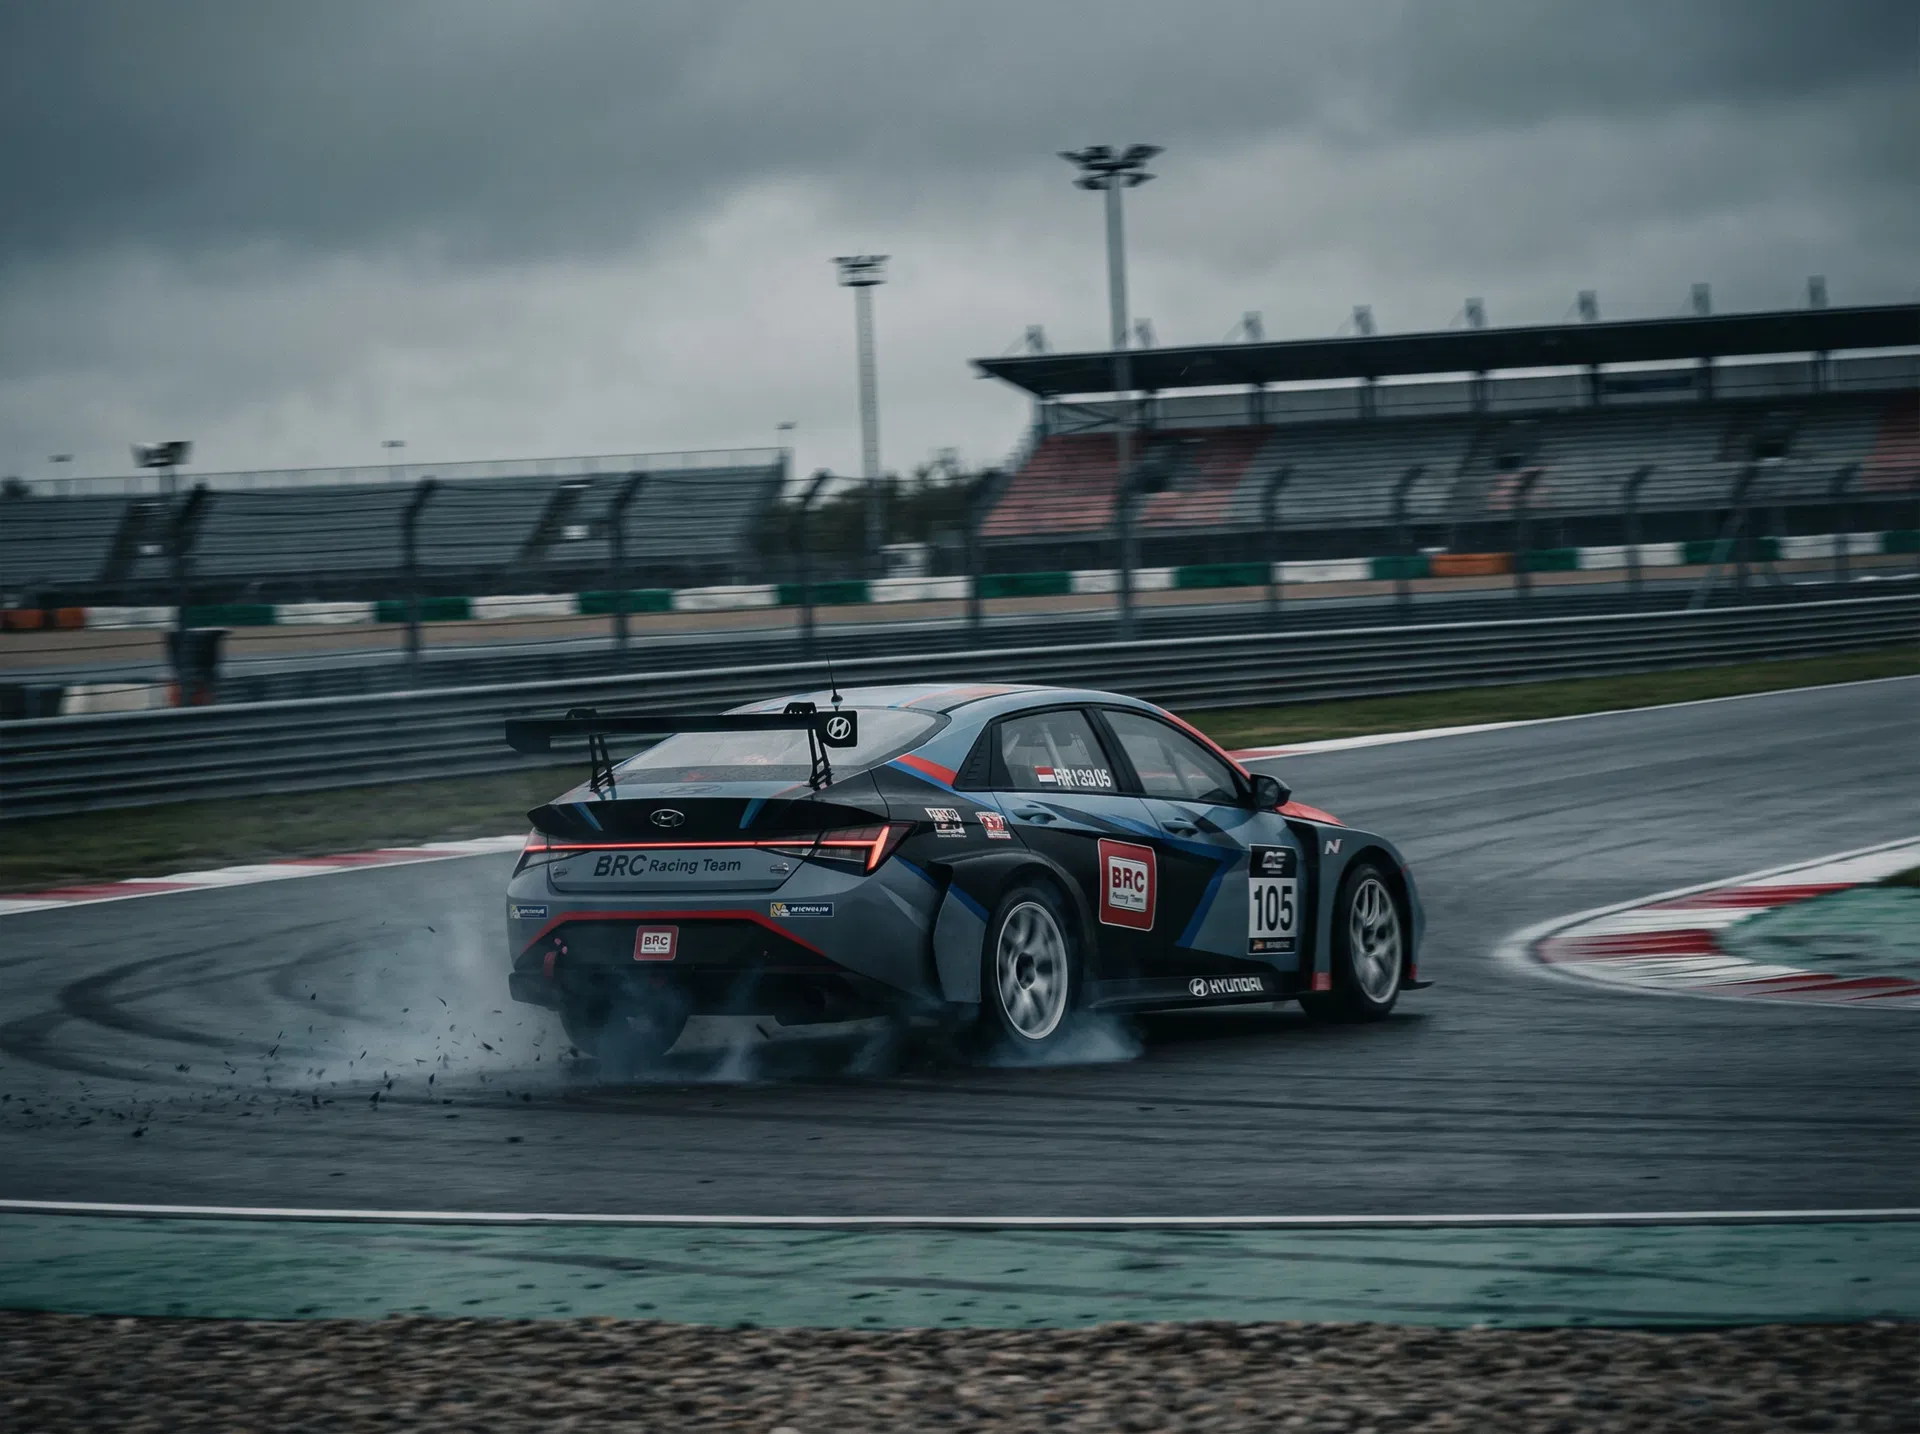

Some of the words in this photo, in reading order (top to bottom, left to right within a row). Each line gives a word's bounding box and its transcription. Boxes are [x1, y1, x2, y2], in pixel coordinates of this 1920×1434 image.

[593, 855, 647, 877] BRC
[648, 859, 698, 875] Racing
[703, 858, 741, 872] Team
[1111, 866, 1145, 893] BRC
[1253, 885, 1293, 932] 105
[644, 935, 668, 946] BRC
[1209, 977, 1264, 994] HYUNDAI
